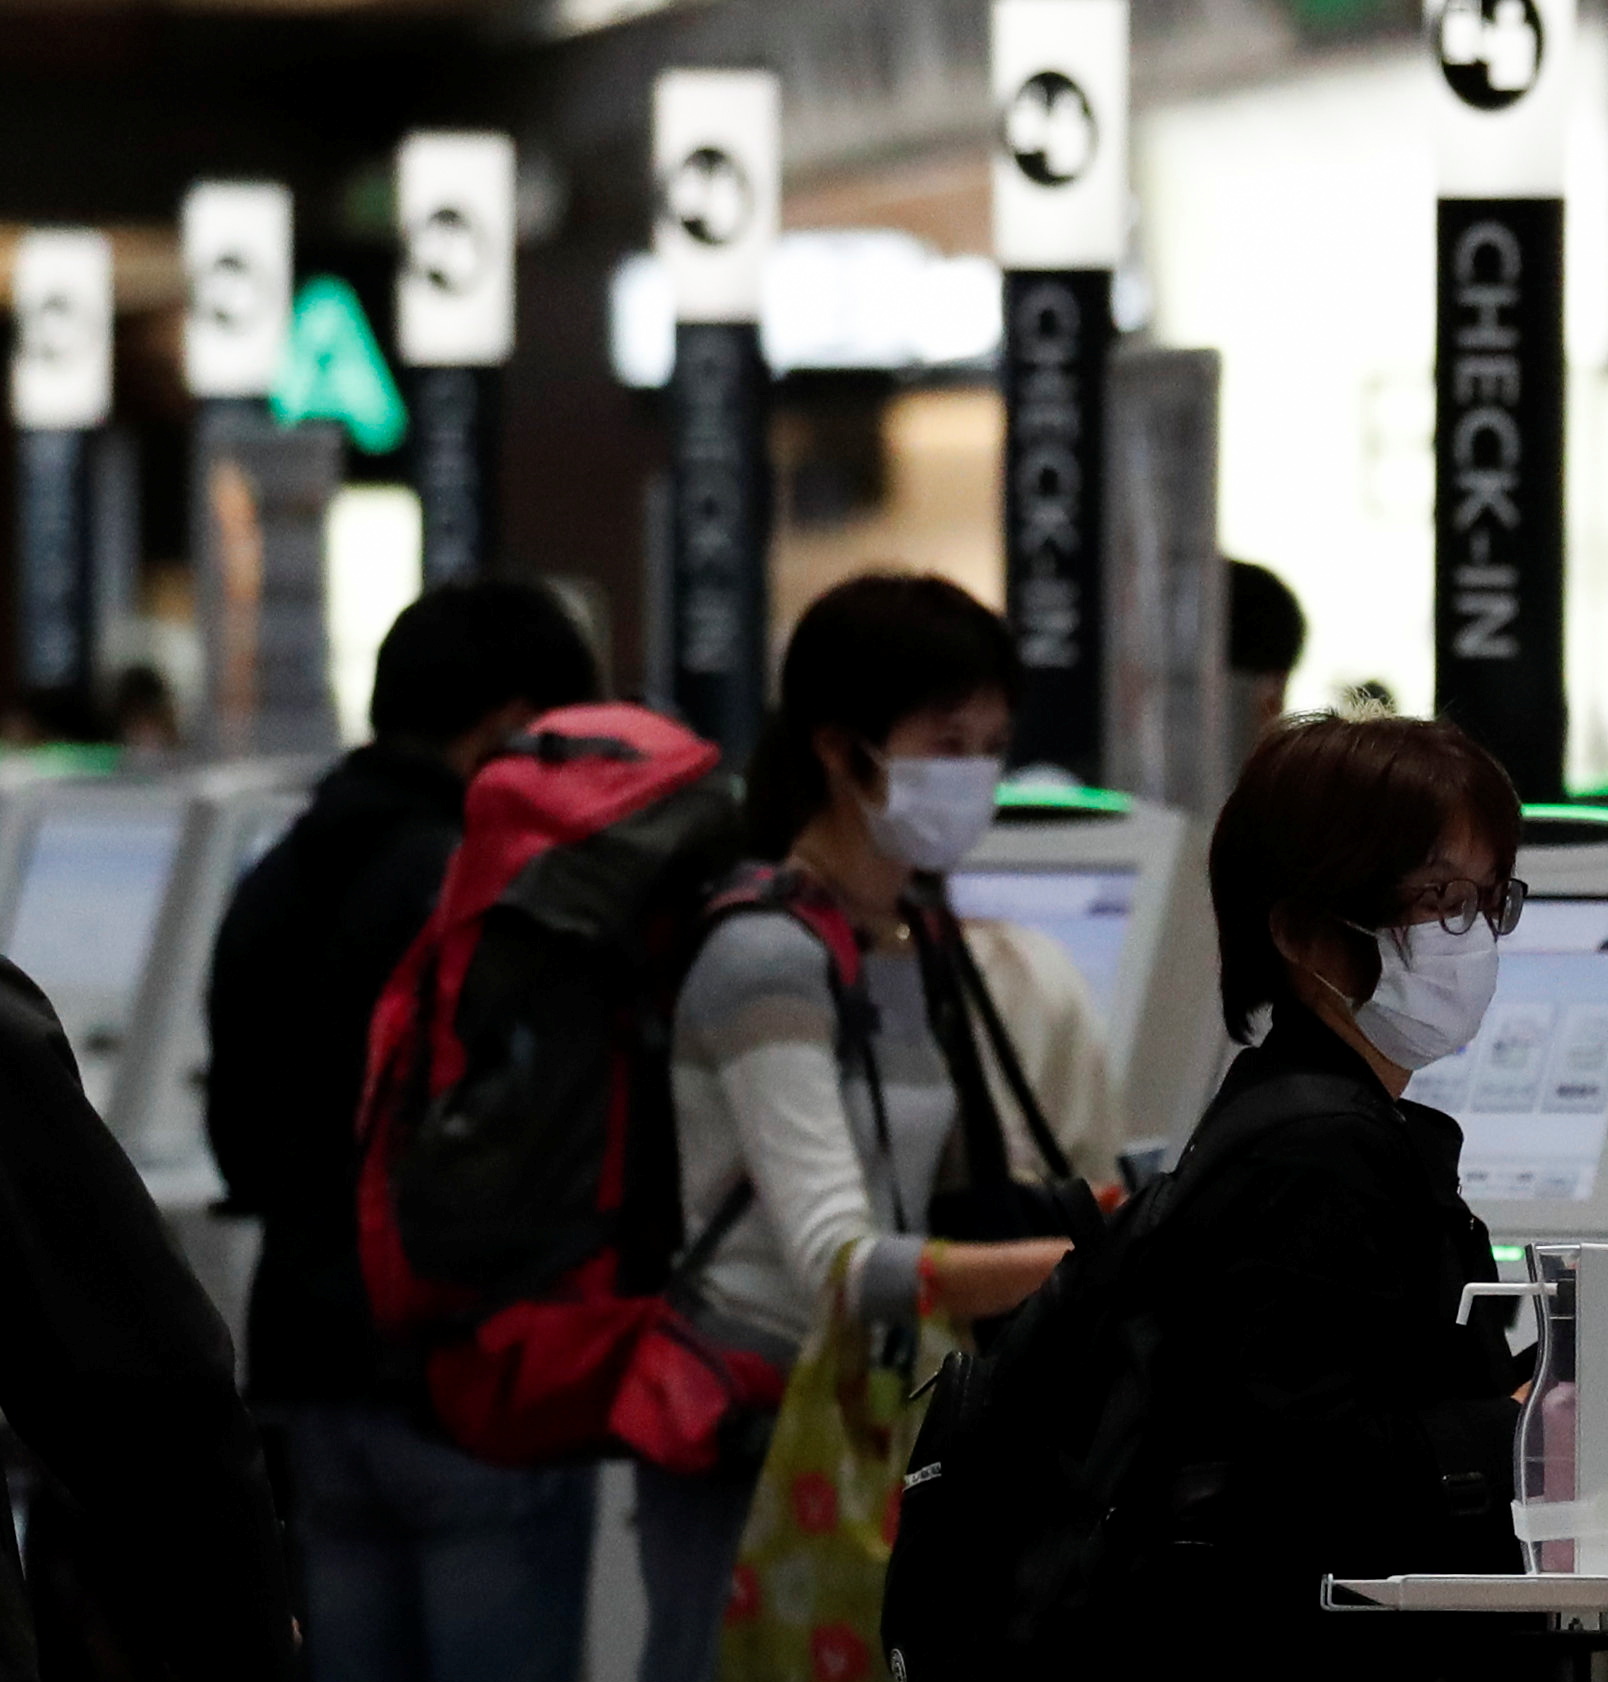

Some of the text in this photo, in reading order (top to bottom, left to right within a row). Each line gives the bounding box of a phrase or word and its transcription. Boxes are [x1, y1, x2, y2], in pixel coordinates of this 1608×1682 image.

[272, 276, 408, 454] A
[1017, 283, 1081, 668] CHECK-IN
[1452, 220, 1522, 660] CHECK-IN
